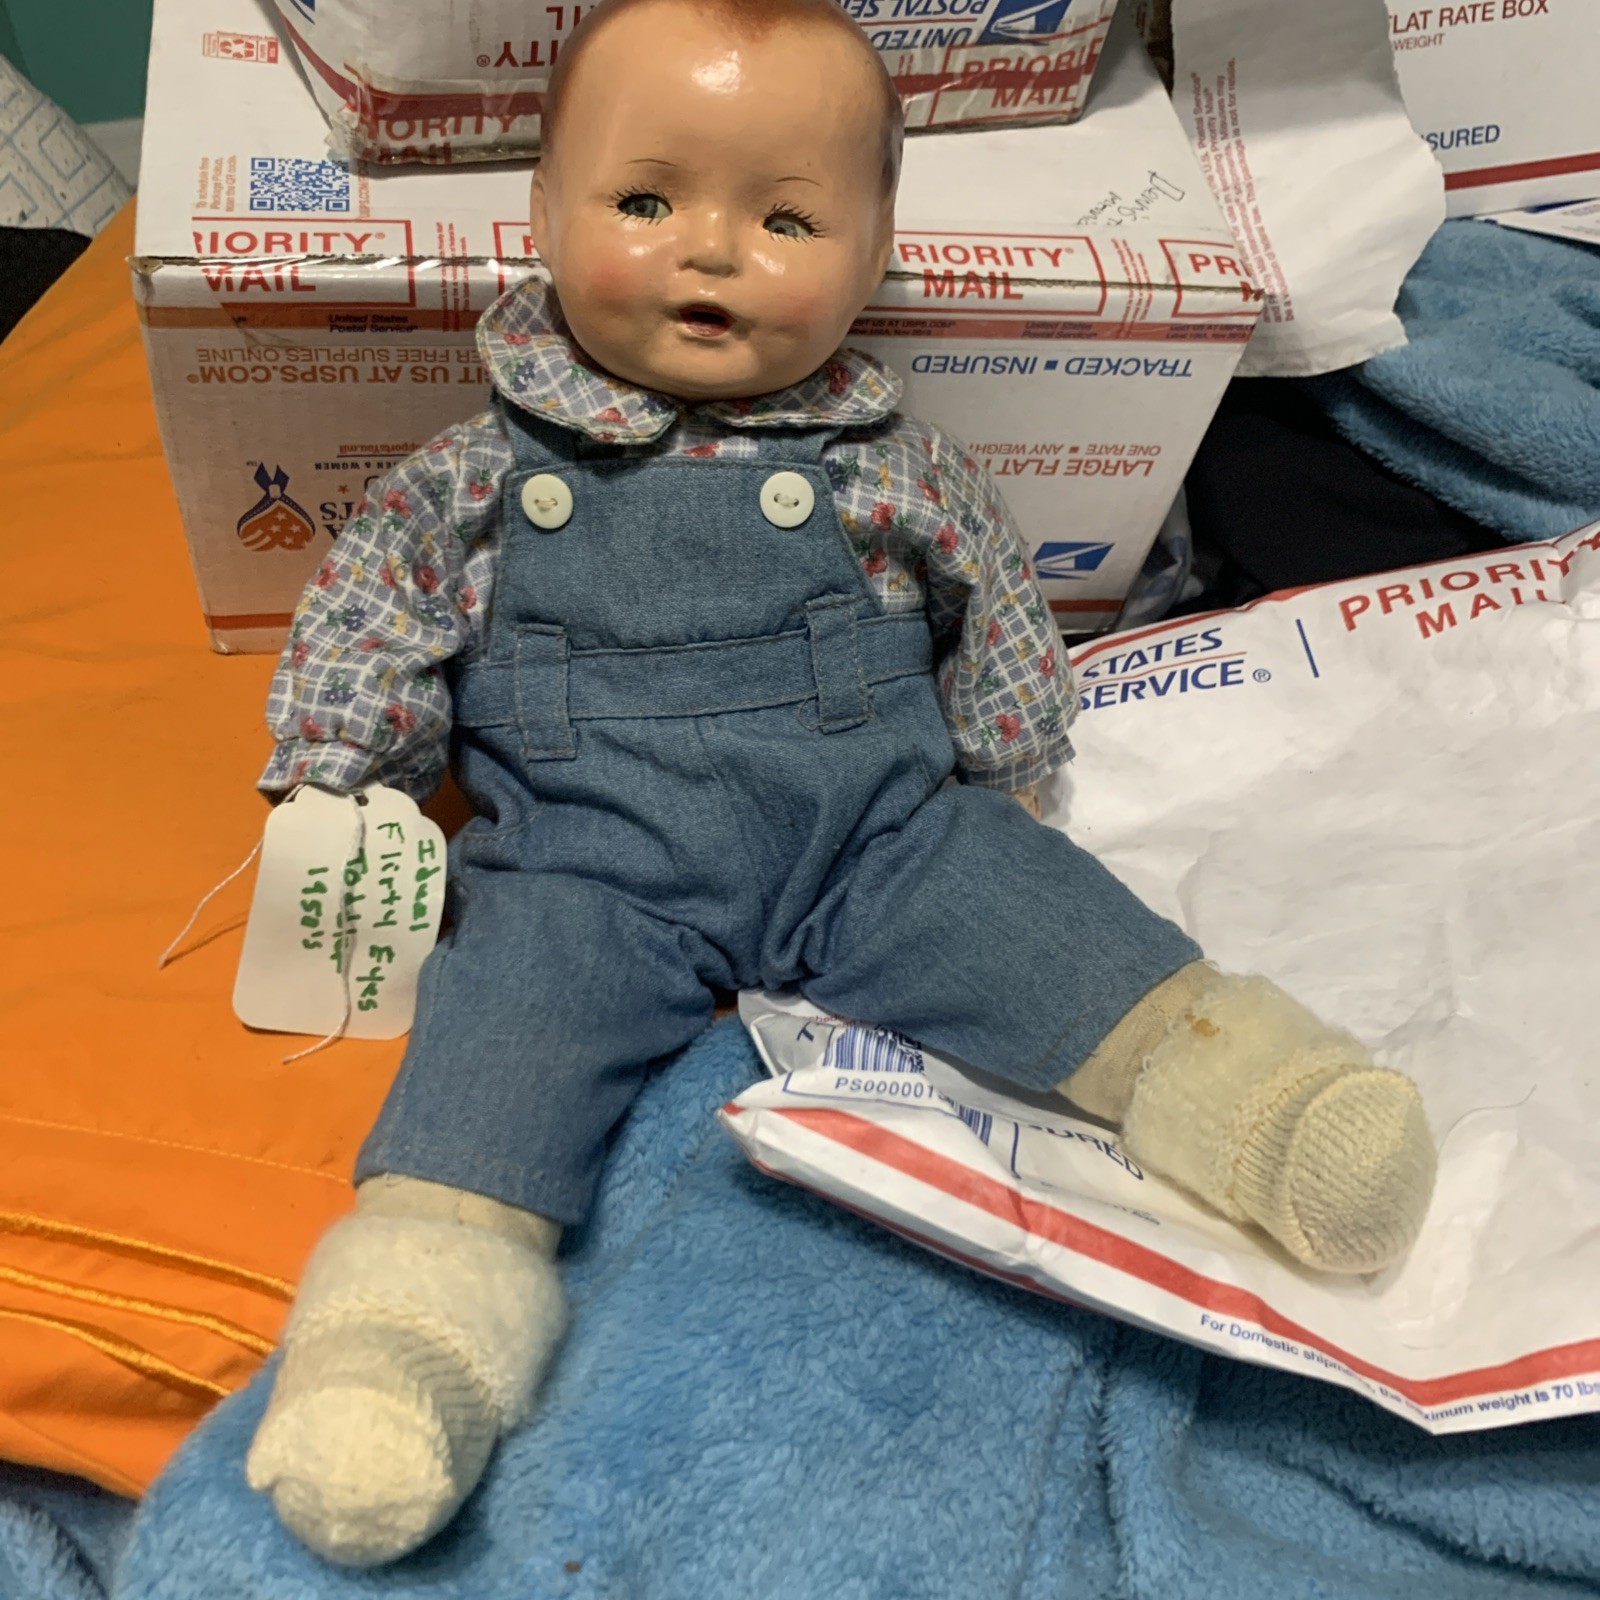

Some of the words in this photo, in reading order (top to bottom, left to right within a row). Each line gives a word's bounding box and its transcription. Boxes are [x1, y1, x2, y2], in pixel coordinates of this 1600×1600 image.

[1389, 11, 1432, 34] LAT
[1438, 2, 1495, 27] RATE
[1502, 0, 1549, 19] BOX
[871, 28, 972, 50] UNITED
[1393, 33, 1445, 50] WEIGHT
[1421, 124, 1500, 151] SURED
[922, 269, 1024, 300] MAIL
[196, 348, 280, 363] ONLINE
[286, 348, 390, 363] SUPPLIES
[396, 348, 449, 363] FREE
[911, 355, 1038, 375] INSURED
[1064, 358, 1192, 377] TRACKED
[366, 366, 403, 384] AT
[409, 365, 450, 384] US
[1028, 443, 1065, 456] ANY
[1085, 444, 1126, 456] RATE
[1127, 444, 1162, 457] ONE
[314, 461, 360, 471] WOMEN
[994, 459, 1060, 476] FLAT
[1063, 459, 1155, 477] LARGE
[1082, 627, 1222, 678] STATES
[372, 822, 405, 928] Flirty
[355, 944, 396, 1011] Eyes
[1200, 1313, 1226, 1333] For
[1229, 1323, 1299, 1356] Domestic
[1477, 1392, 1532, 1415] weight
[1552, 1382, 1574, 1401] 70
